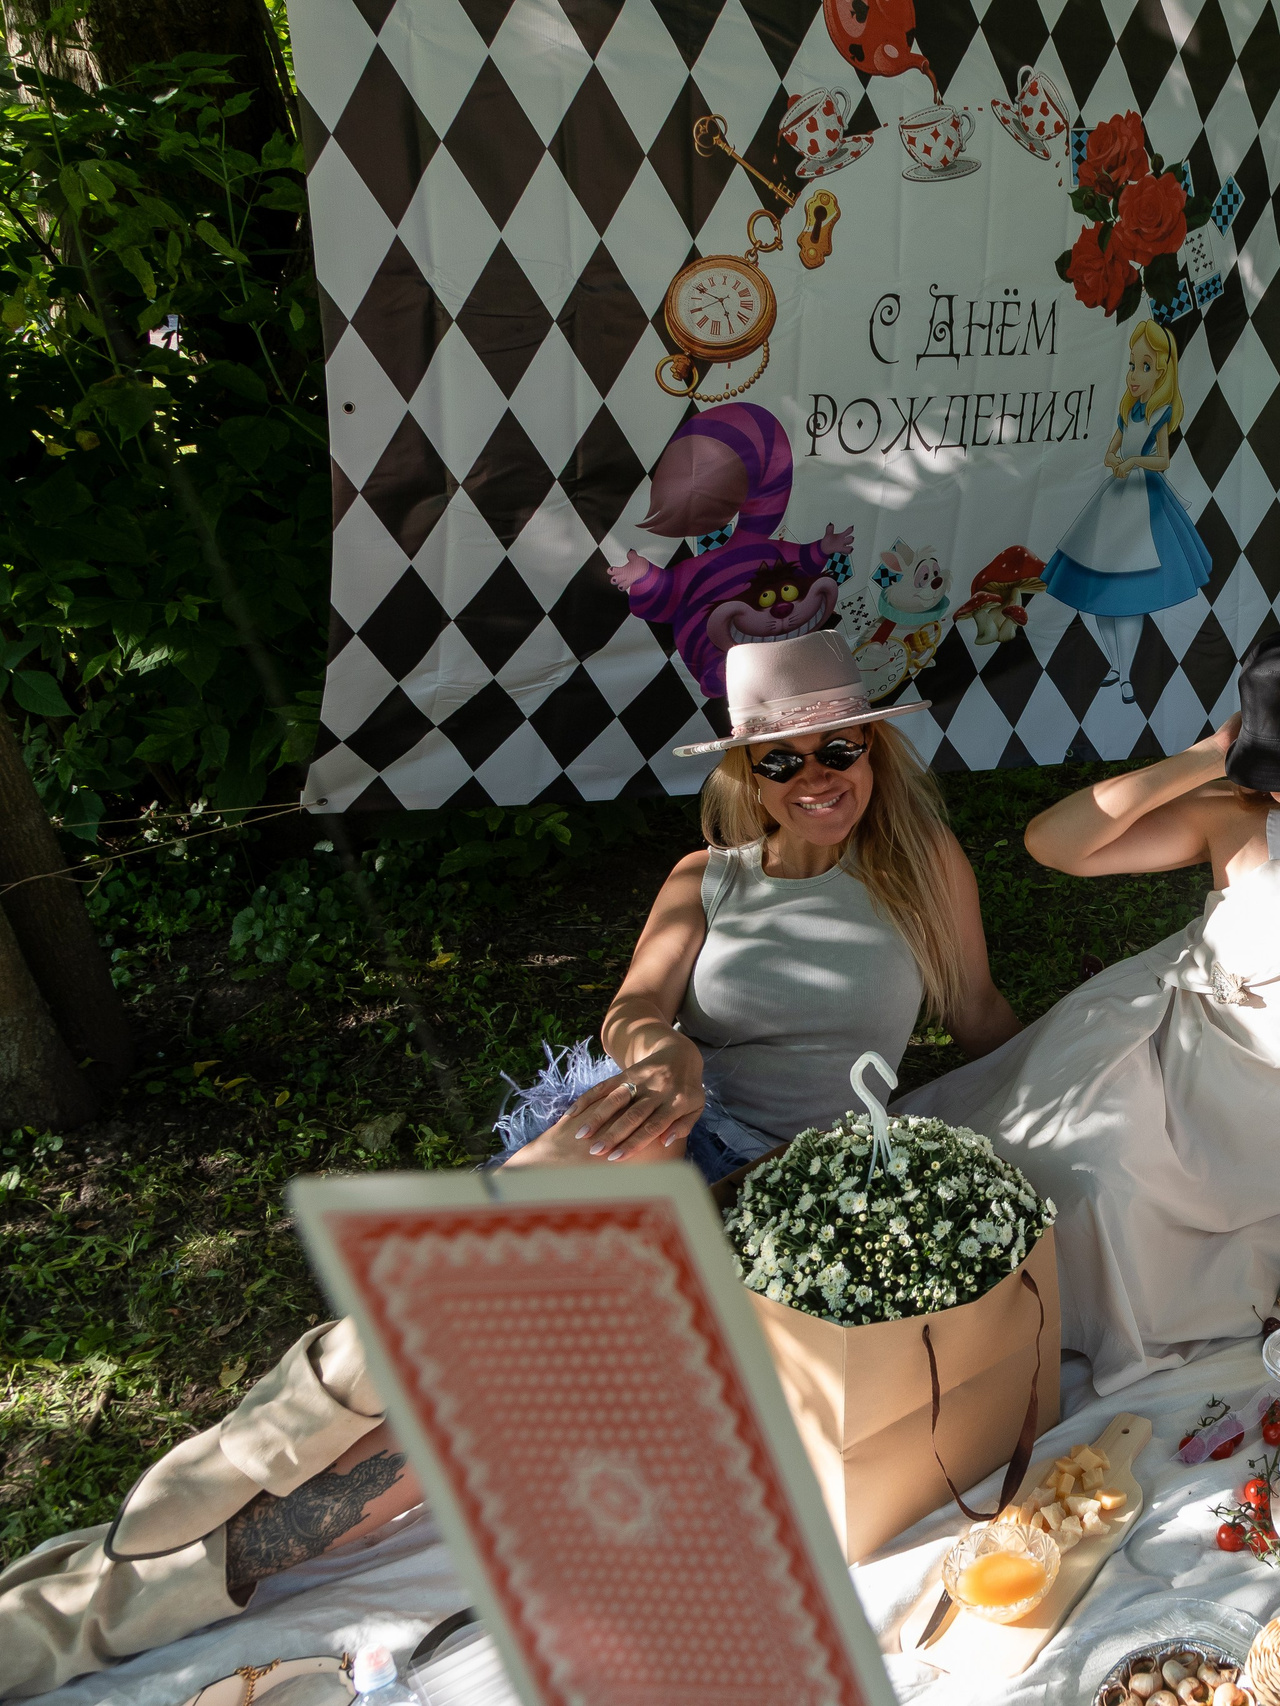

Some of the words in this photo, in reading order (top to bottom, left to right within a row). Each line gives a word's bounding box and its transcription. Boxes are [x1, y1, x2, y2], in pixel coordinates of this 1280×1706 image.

[869, 293, 901, 365] С
[916, 283, 1059, 371] ДНЁМ
[804, 384, 1096, 459] РОЖДЕНИЯ!
